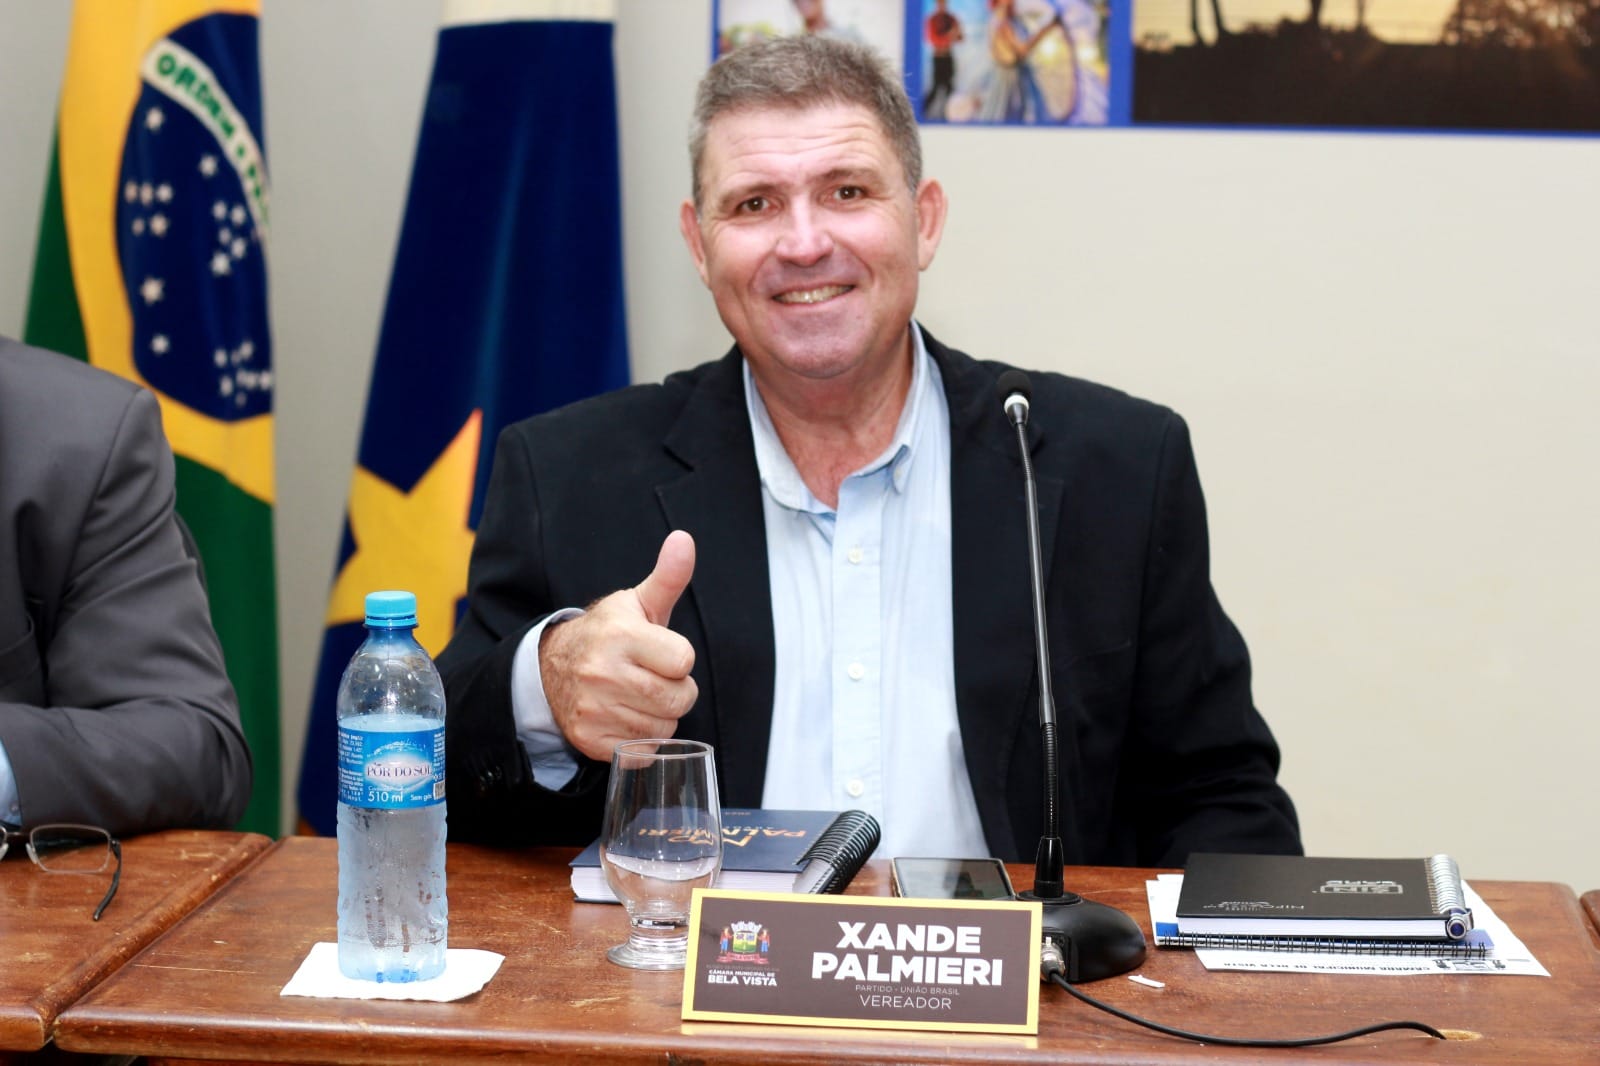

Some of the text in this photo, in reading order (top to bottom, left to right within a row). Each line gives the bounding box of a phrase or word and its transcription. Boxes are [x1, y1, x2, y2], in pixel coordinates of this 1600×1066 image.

[367, 791, 404, 803] 510 ml
[836, 921, 982, 953] XANDE
[811, 951, 1003, 986] PALMIERI
[707, 974, 777, 987] BELA VISTA
[855, 984, 893, 993] PARTIDO
[900, 984, 928, 994] UNIÃO
[929, 987, 960, 996] BRASIL
[859, 994, 953, 1010] VEREADOR
